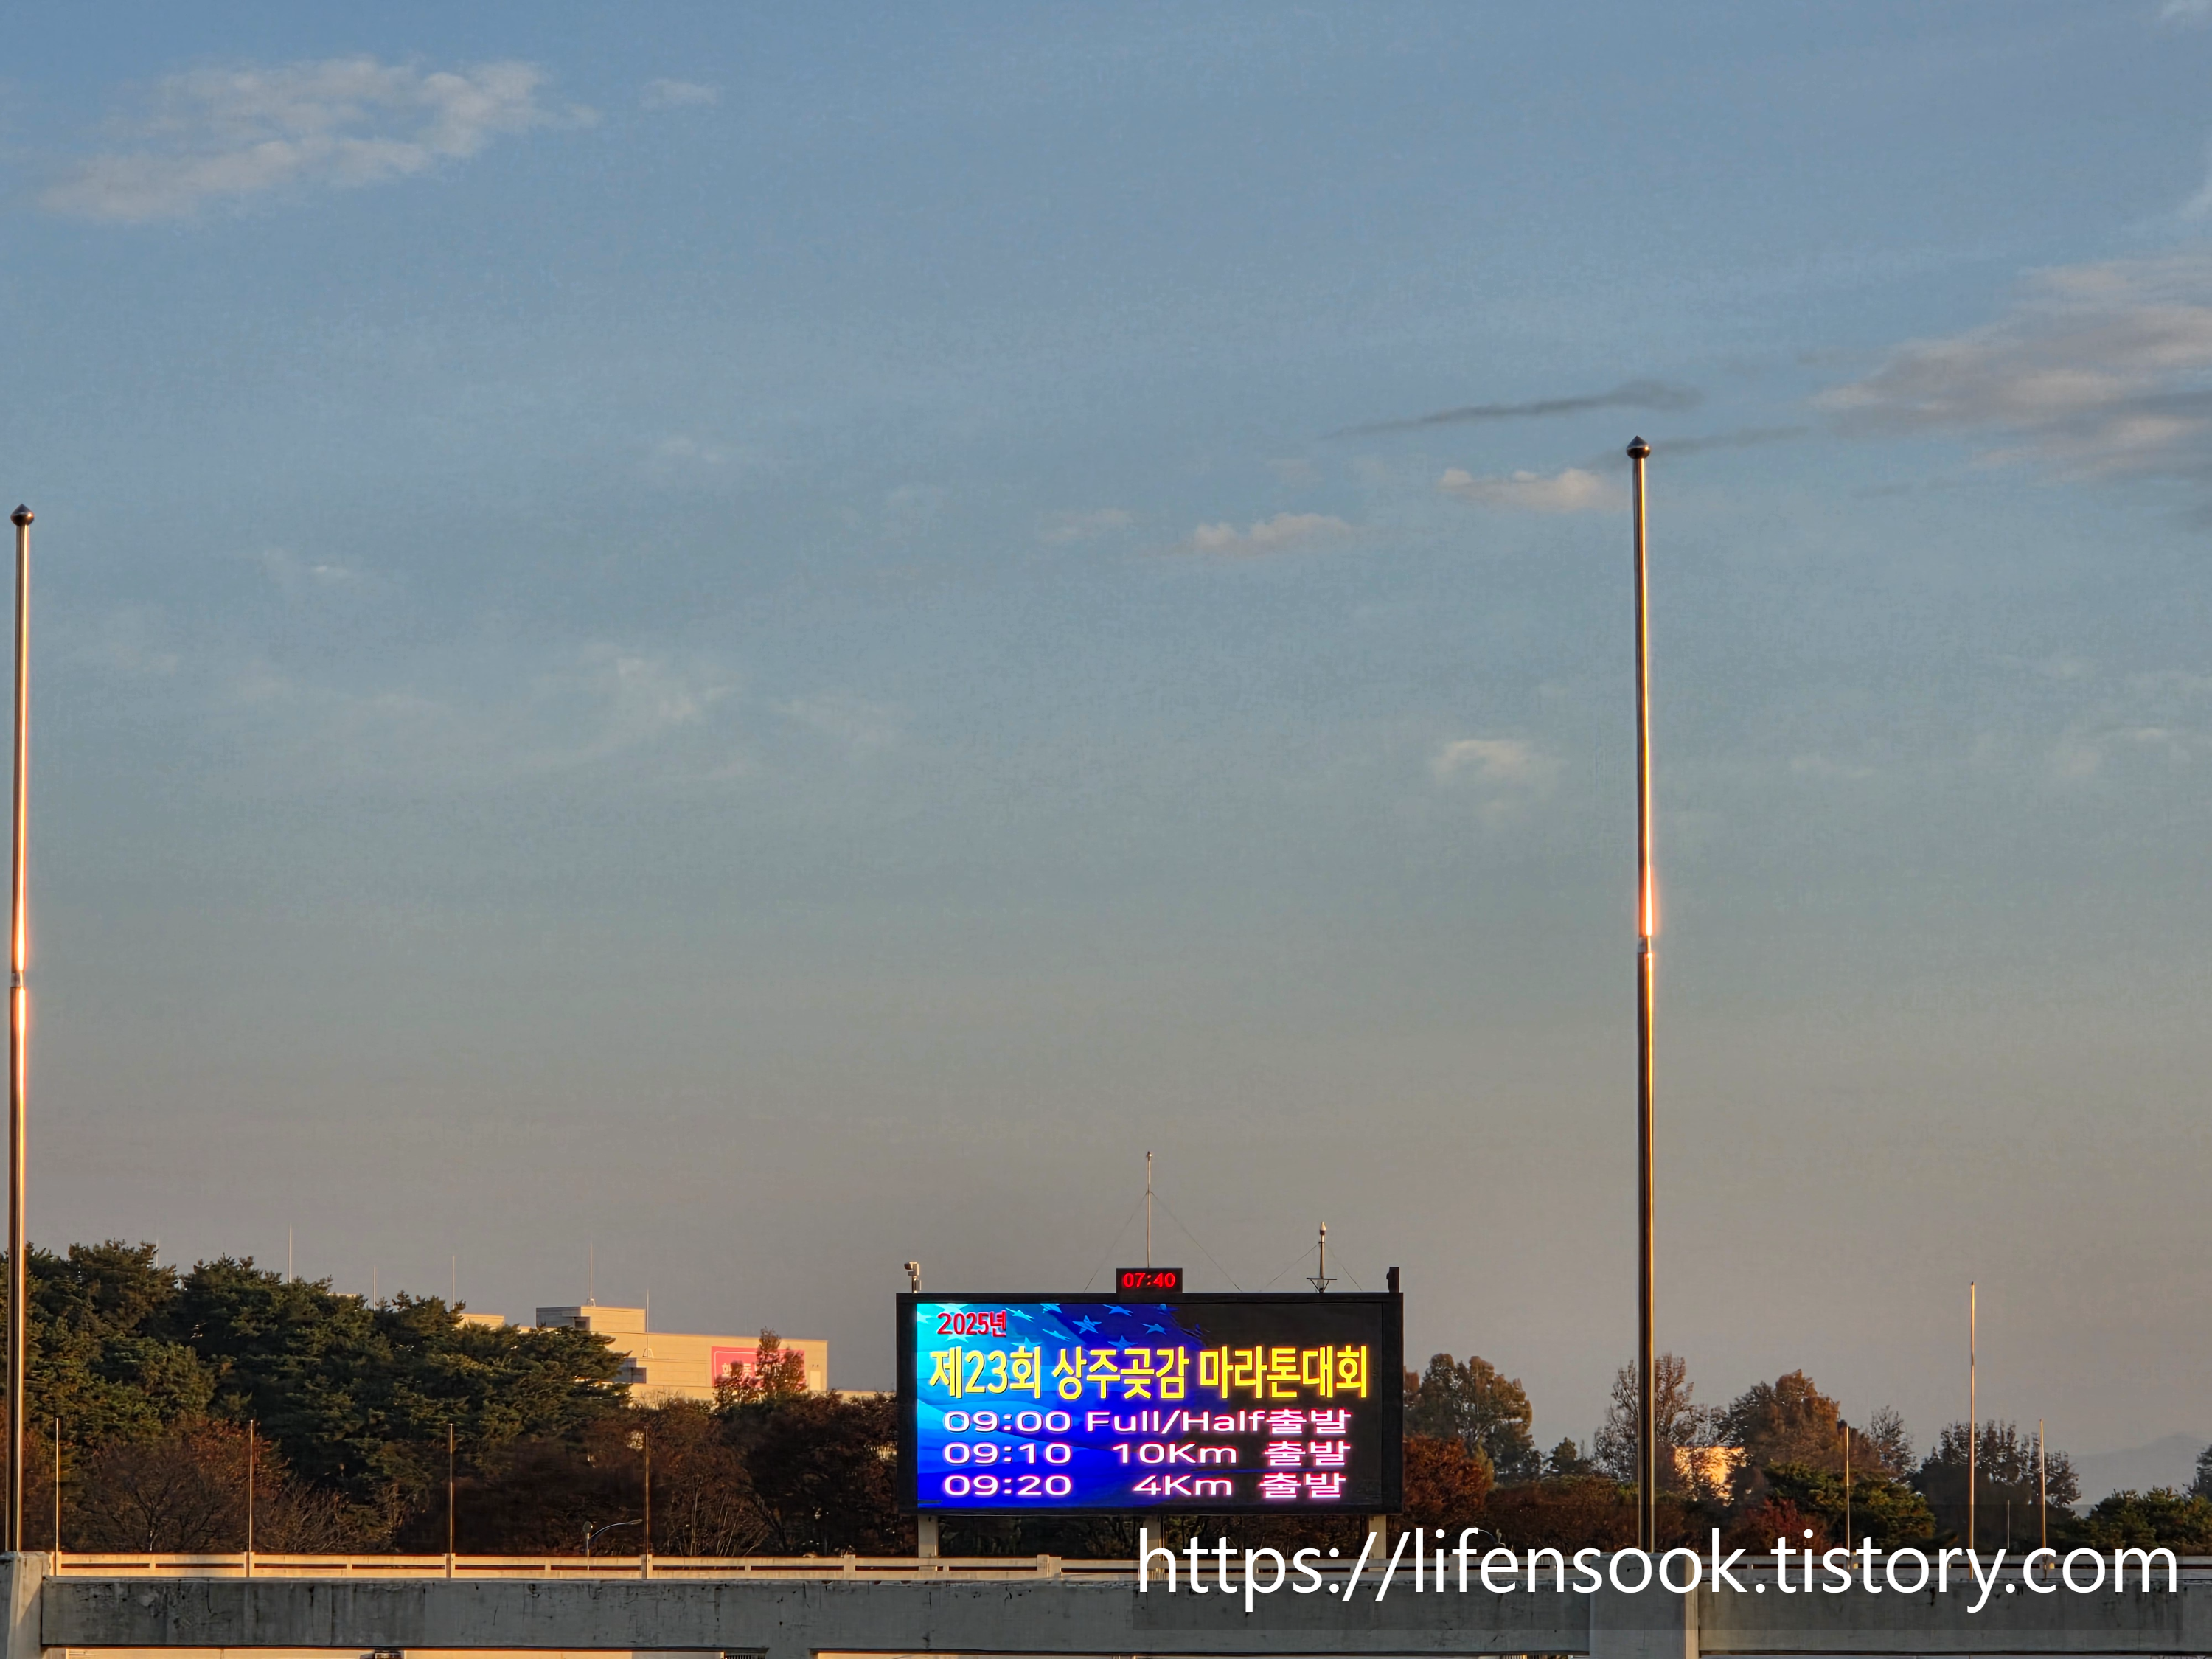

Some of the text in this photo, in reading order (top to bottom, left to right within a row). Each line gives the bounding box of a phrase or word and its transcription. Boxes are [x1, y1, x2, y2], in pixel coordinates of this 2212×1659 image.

[1122, 1273, 1175, 1288] 07:40
[937, 1309, 1006, 1337] 2025년
[930, 1346, 1368, 1398] 제23회 상주곶감 마라톤대회
[944, 1411, 1071, 1431] 09:00
[944, 1441, 1351, 1466] 09:10 10Km 출발
[944, 1472, 1346, 1498] 09:20 4Km 출발
